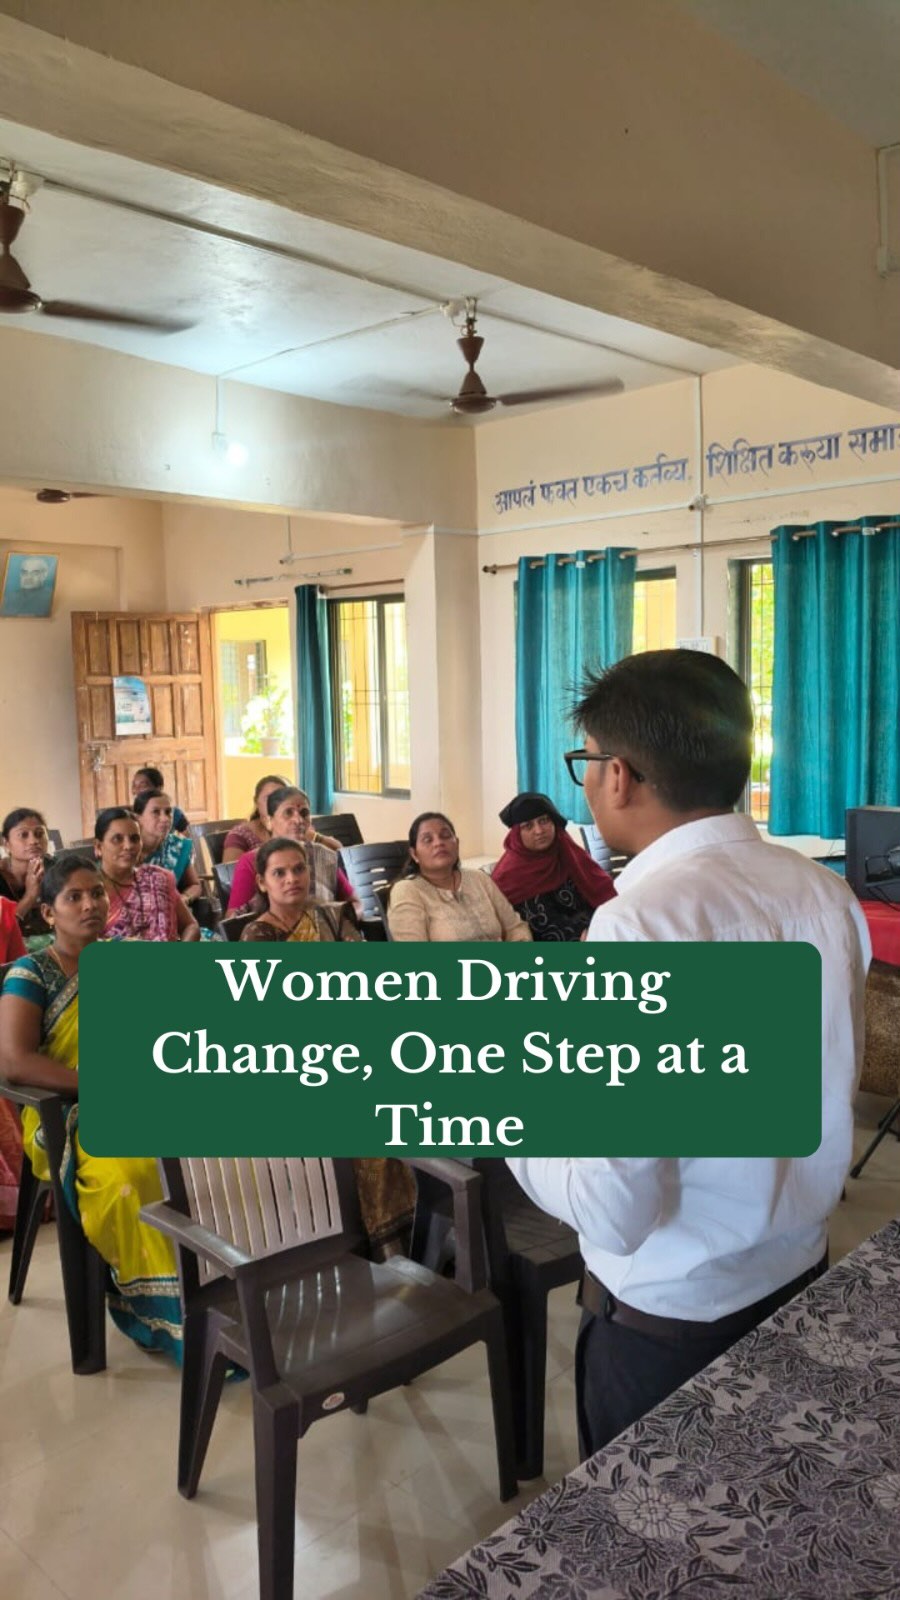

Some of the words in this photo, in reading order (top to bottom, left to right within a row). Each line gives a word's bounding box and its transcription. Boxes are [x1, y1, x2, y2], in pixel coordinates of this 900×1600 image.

[493, 480, 537, 514] आपलं
[582, 469, 629, 497] एकच
[706, 437, 775, 486] शिक्षित
